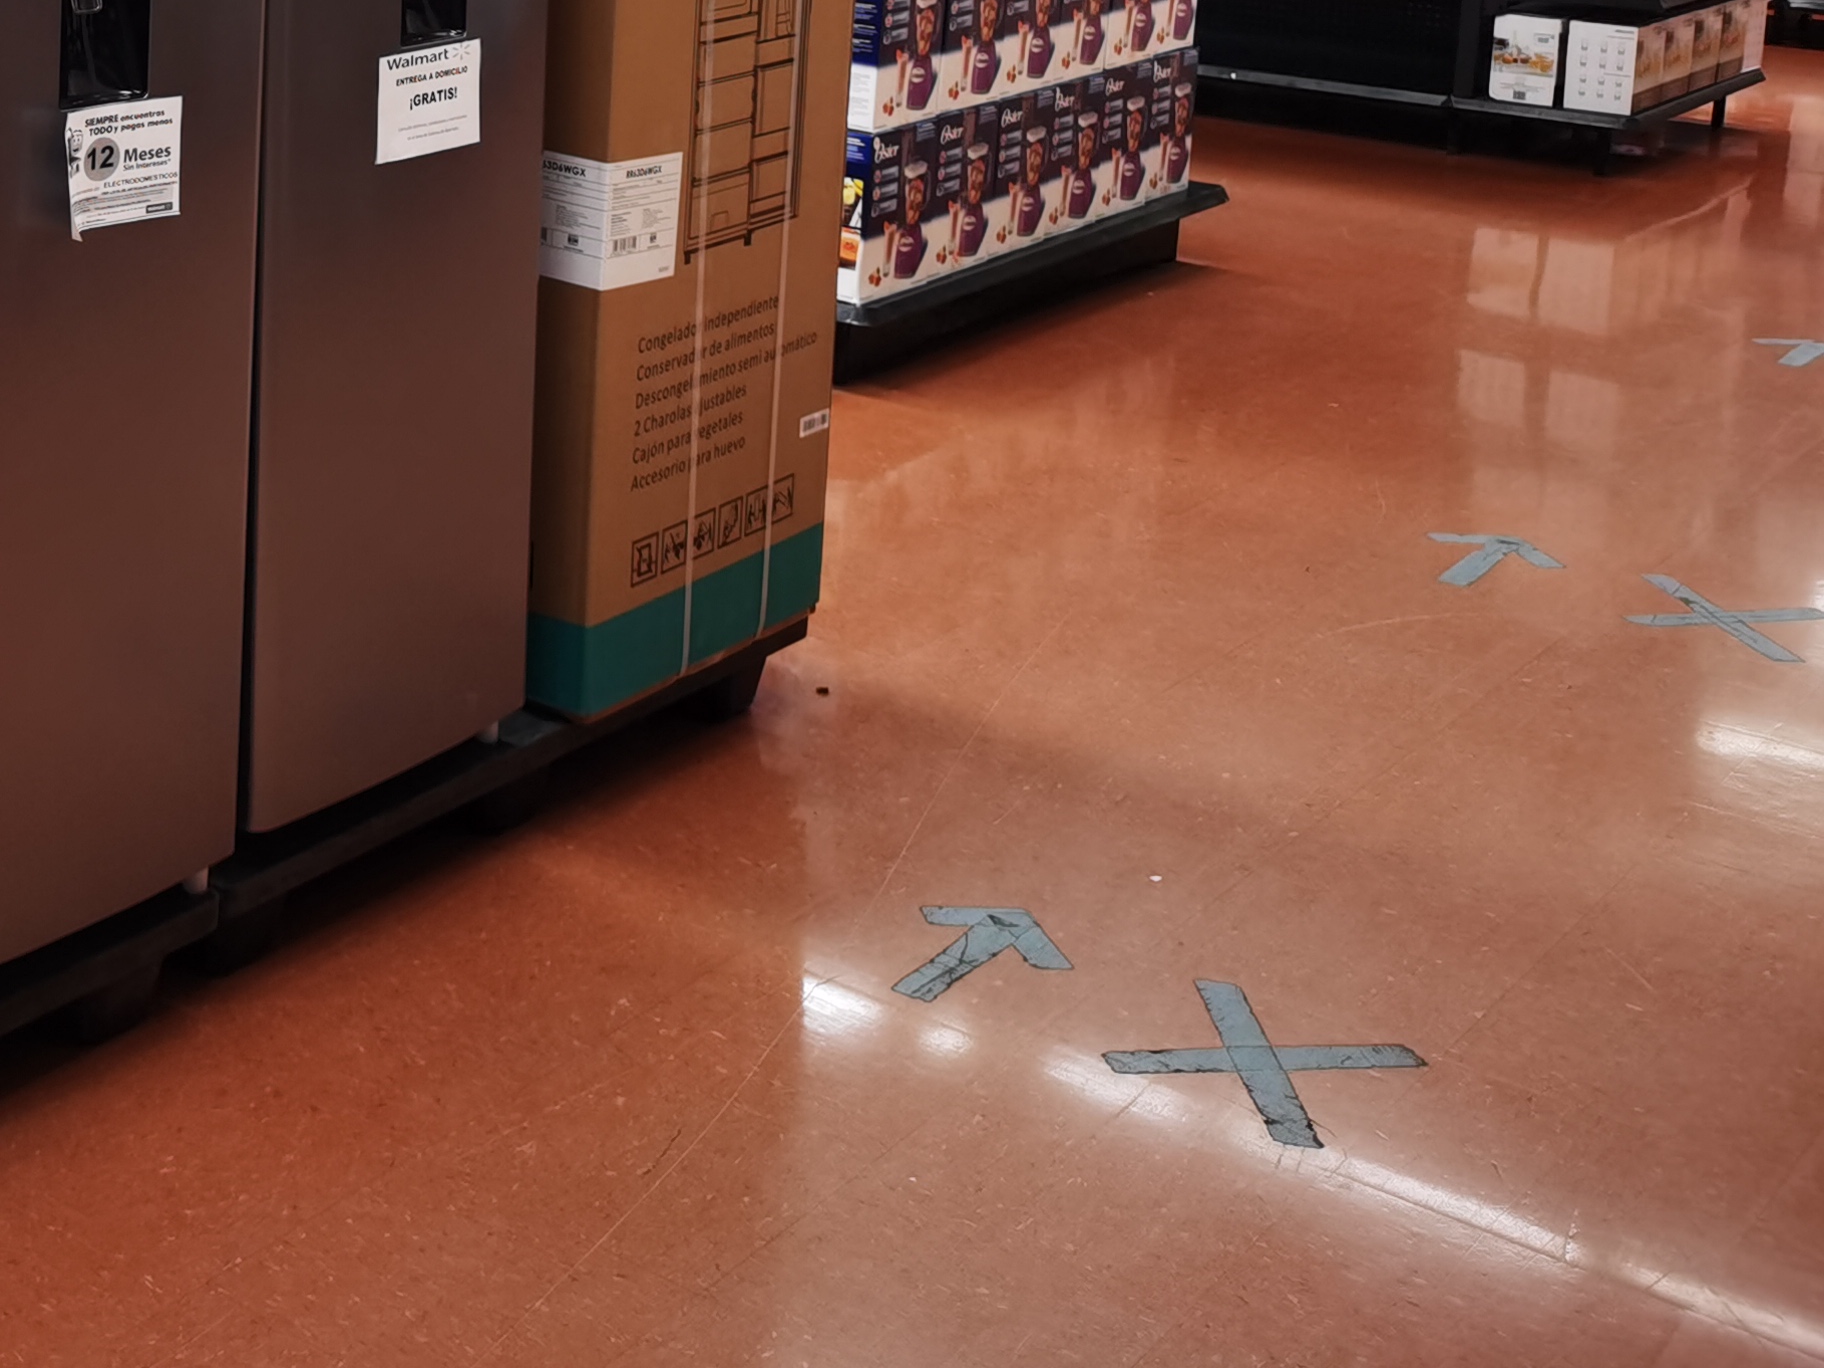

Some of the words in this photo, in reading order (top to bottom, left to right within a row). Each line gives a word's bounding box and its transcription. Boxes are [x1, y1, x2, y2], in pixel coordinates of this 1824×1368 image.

[386, 48, 450, 71] Walmart
[396, 73, 427, 87] ENTREGA
[434, 65, 468, 79] DOMICILIO
[409, 86, 458, 111] ¡GRATIS!
[85, 114, 119, 128] SIEMPRE
[120, 110, 165, 122] encuentras
[89, 125, 113, 137] TODO
[120, 122, 145, 133] pagas
[147, 118, 173, 127] menos
[87, 145, 115, 171] 12
[123, 146, 172, 164] Meses
[123, 164, 135, 172] Sin
[542, 159, 587, 178] 63D6WGX
[638, 320, 700, 354] Congelado
[704, 295, 779, 332] independiente
[636, 345, 707, 382] Conservadr
[709, 340, 723, 357] de
[724, 322, 775, 352] alimentos
[635, 362, 737, 410] Descongelmiento
[737, 350, 763, 374] semi
[763, 331, 818, 364] auomático
[634, 420, 642, 437] 2
[643, 403, 693, 434] Charolas
[697, 384, 747, 417] justables
[667, 431, 692, 452] para
[695, 411, 744, 440] egetales
[630, 460, 686, 493] Accesorio
[713, 436, 746, 459] huevo
